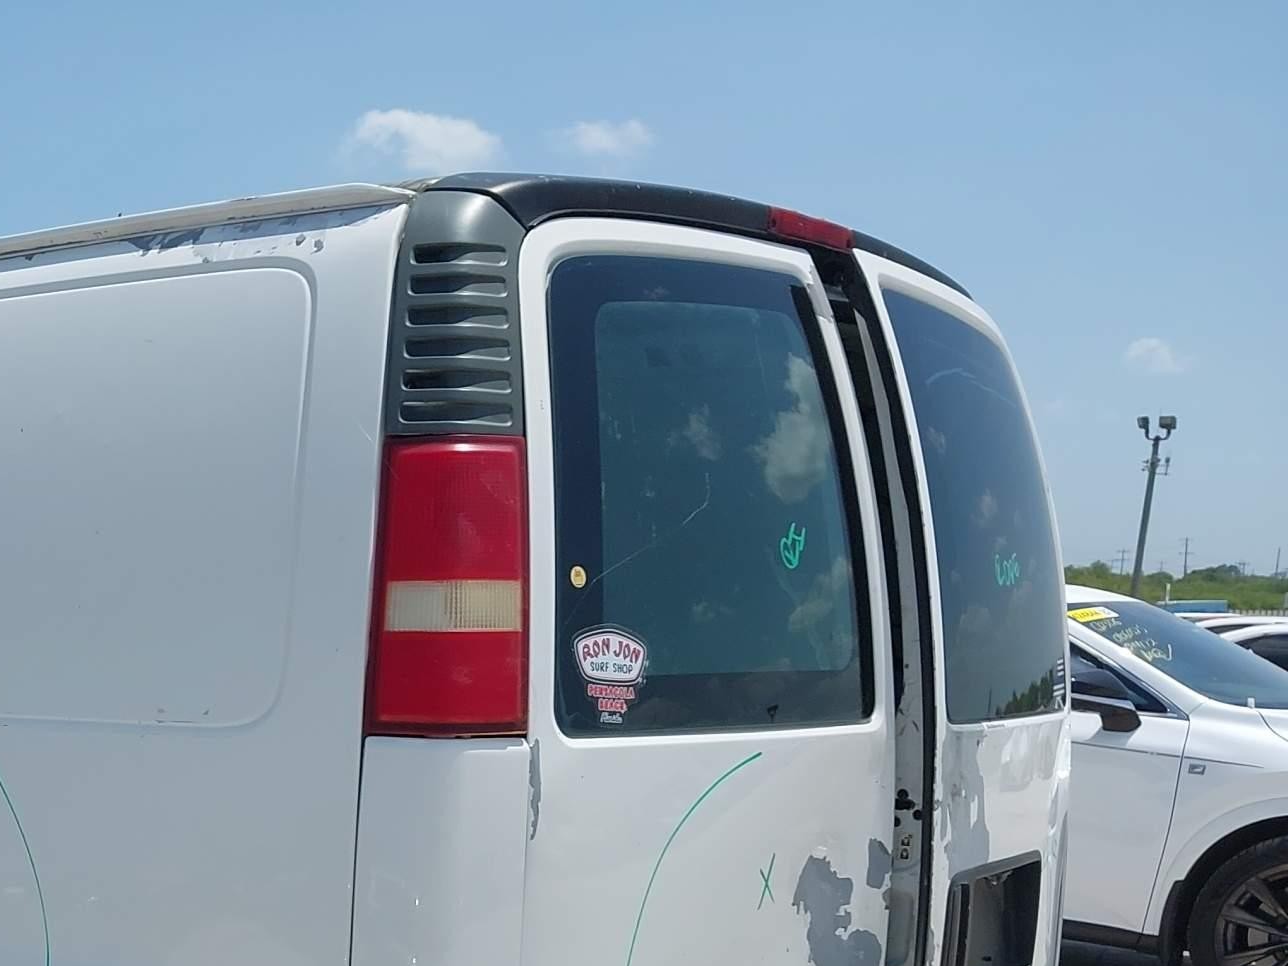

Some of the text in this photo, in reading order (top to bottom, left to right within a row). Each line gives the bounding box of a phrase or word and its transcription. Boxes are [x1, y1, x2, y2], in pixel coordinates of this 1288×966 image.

[582, 637, 641, 664] RON JON
[590, 661, 634, 675] SURF SHOP
